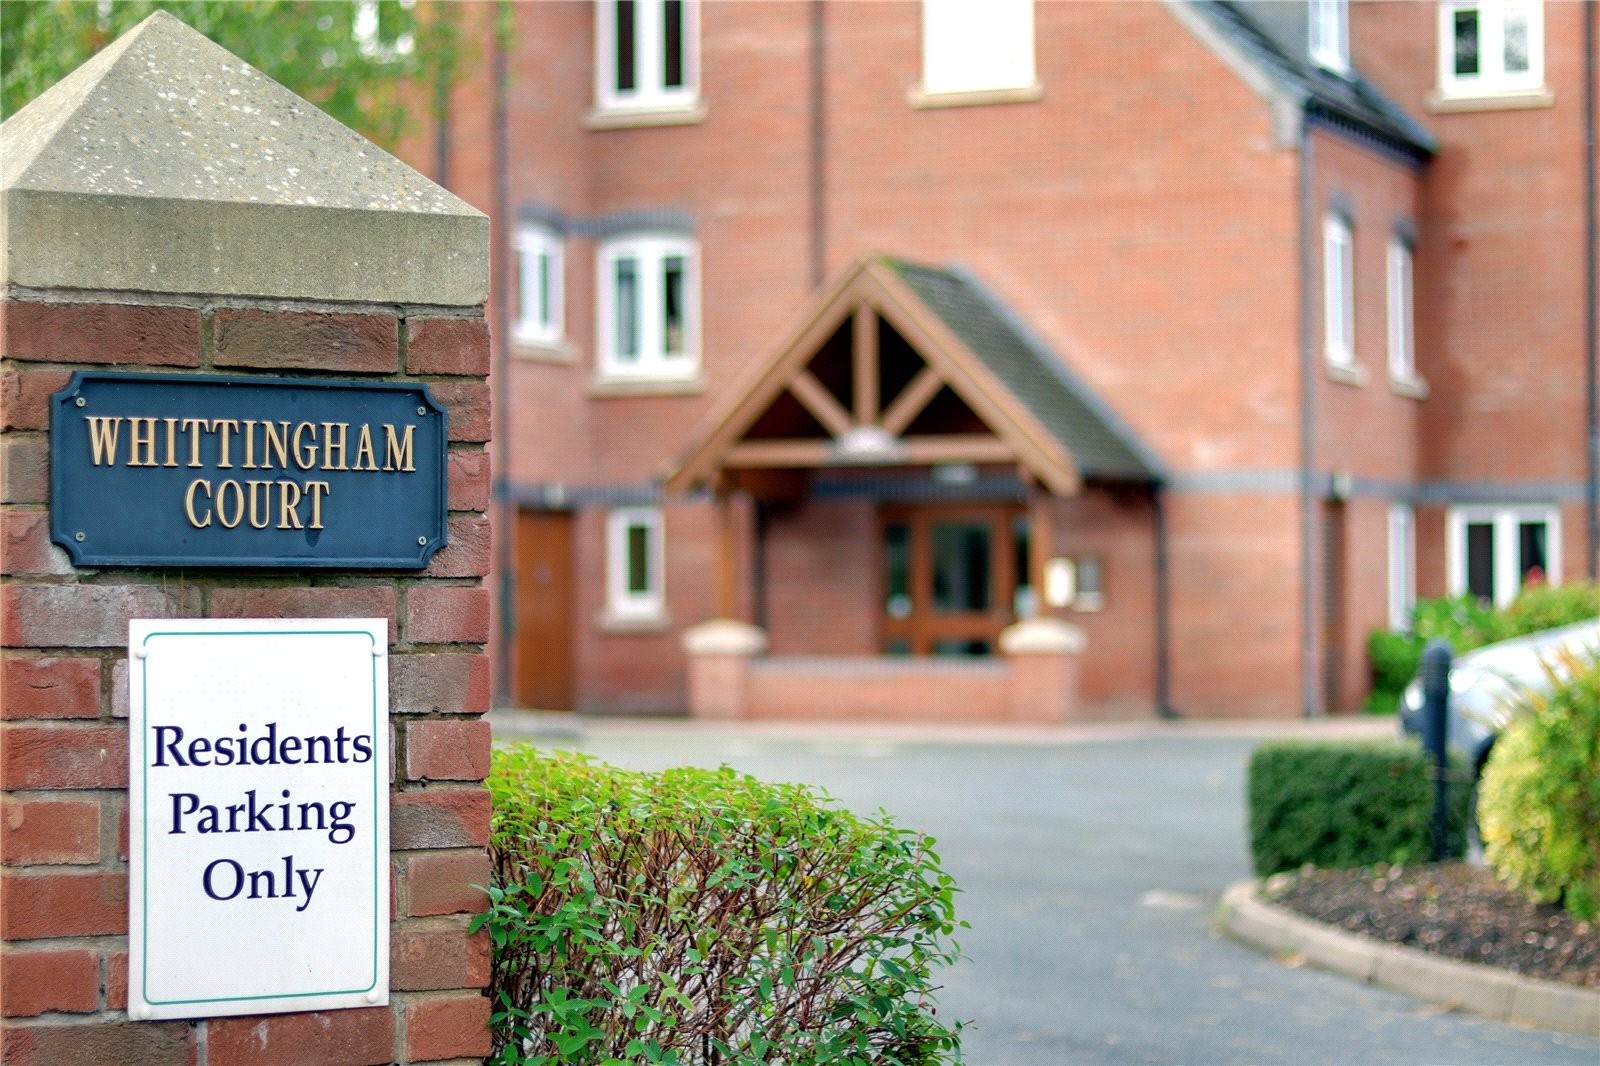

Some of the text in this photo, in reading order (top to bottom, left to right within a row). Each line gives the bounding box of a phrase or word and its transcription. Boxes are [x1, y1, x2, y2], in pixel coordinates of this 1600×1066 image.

[85, 416, 417, 473] WHITTINGHAM
[185, 479, 330, 530] COURT
[151, 722, 373, 768] Residents
[168, 789, 356, 844] Parking
[203, 855, 325, 912] Only
